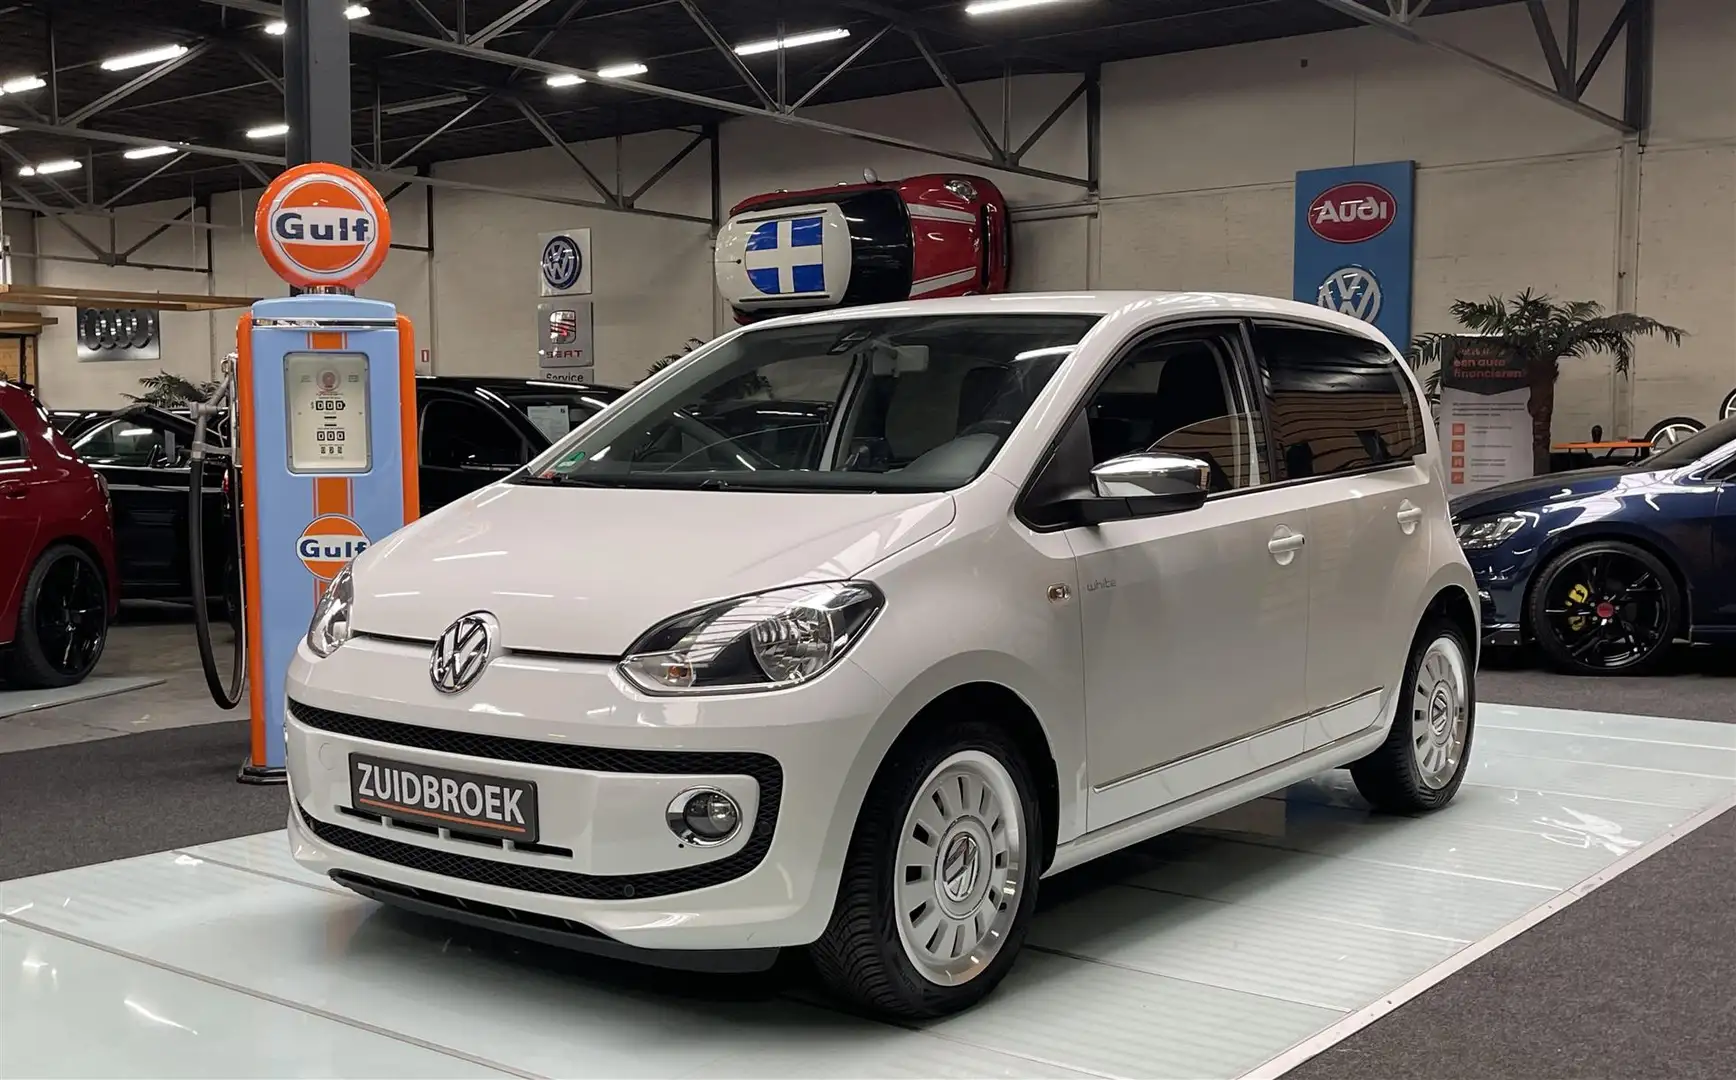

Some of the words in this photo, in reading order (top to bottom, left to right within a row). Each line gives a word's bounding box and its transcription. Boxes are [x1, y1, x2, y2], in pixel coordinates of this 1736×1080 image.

[275, 212, 370, 242] Gulf
[546, 349, 583, 359] SEAT
[300, 539, 367, 558] Gulf
[1087, 578, 1117, 592] white
[357, 762, 526, 825] ZUIDBROEK
